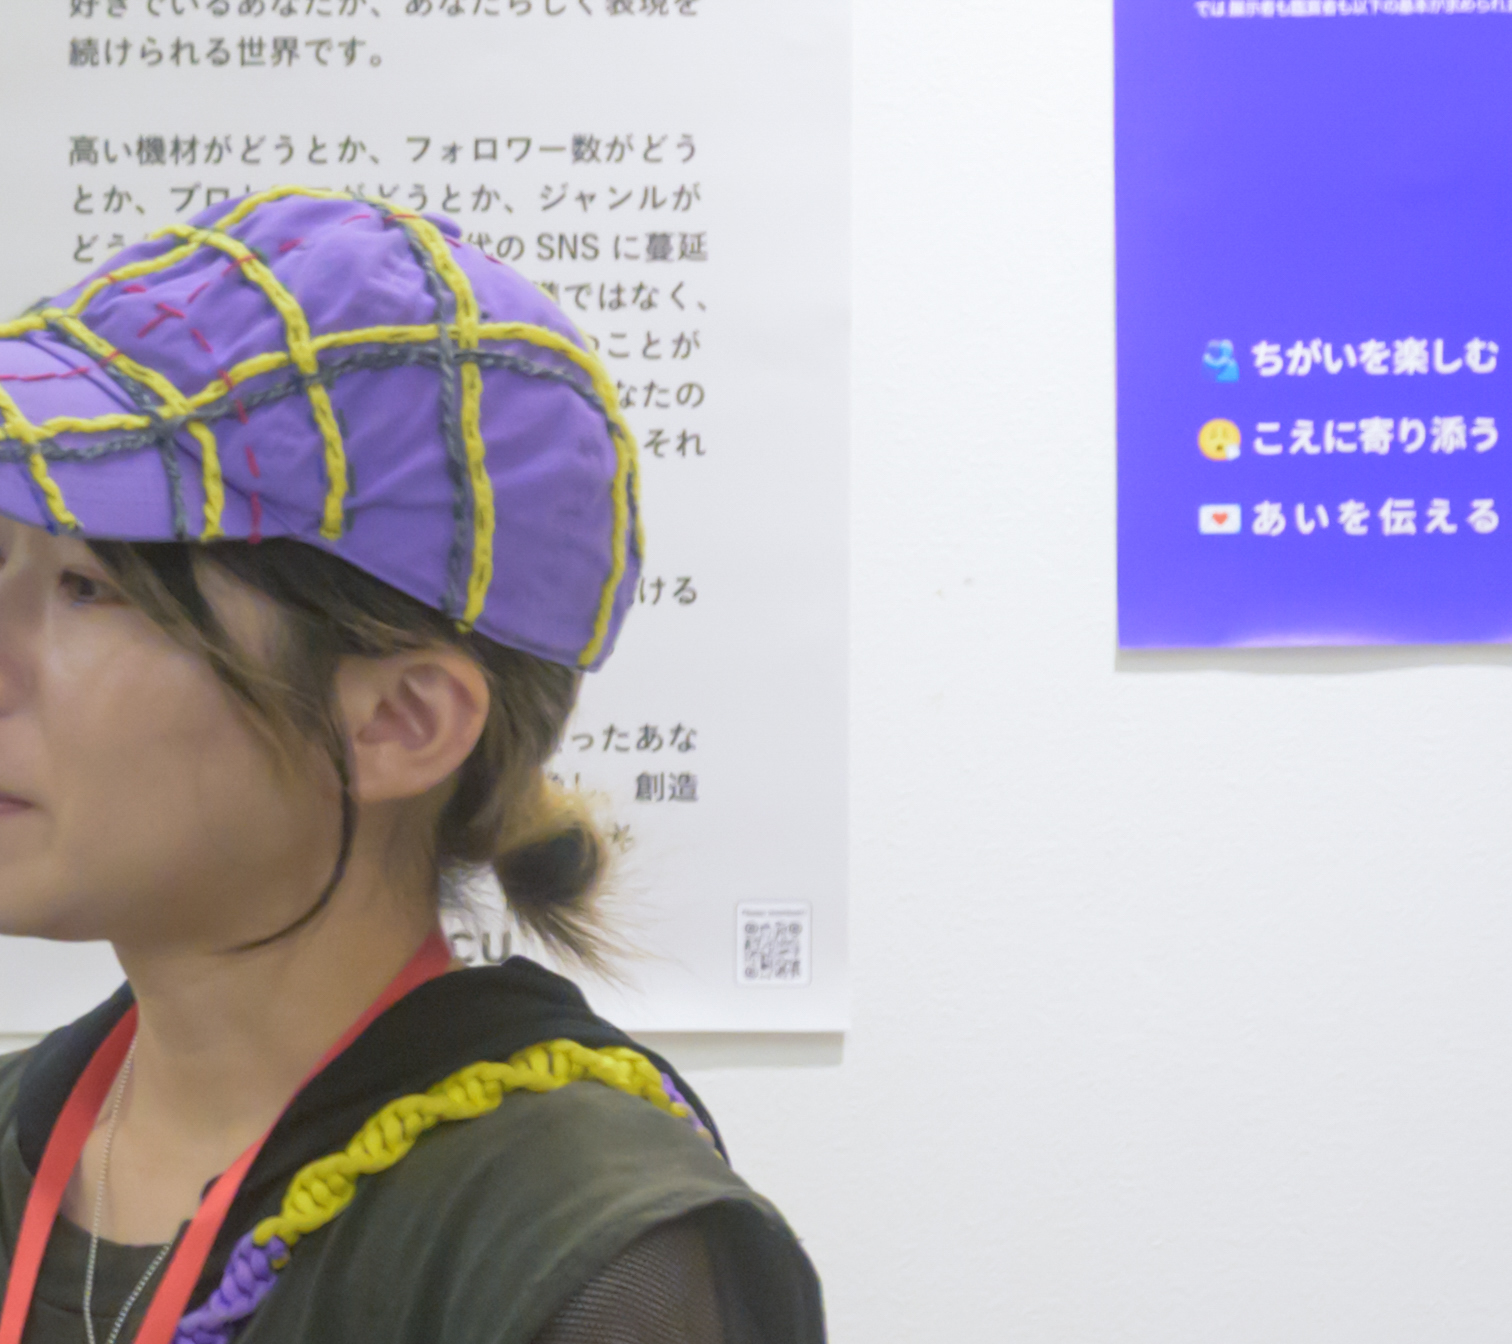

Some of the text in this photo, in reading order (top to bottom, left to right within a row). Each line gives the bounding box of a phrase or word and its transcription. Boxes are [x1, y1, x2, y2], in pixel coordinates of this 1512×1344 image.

[67, 36, 382, 69] 続けられる世界です。
[68, 133, 696, 167] 高い機材がどうとか、フォロワー数がどう
[535, 231, 601, 262] SNS
[1251, 337, 1500, 377] ちがいを楽しむ
[1252, 415, 1500, 455] こえに寄り添う
[1251, 497, 1500, 537] あいを伝える
